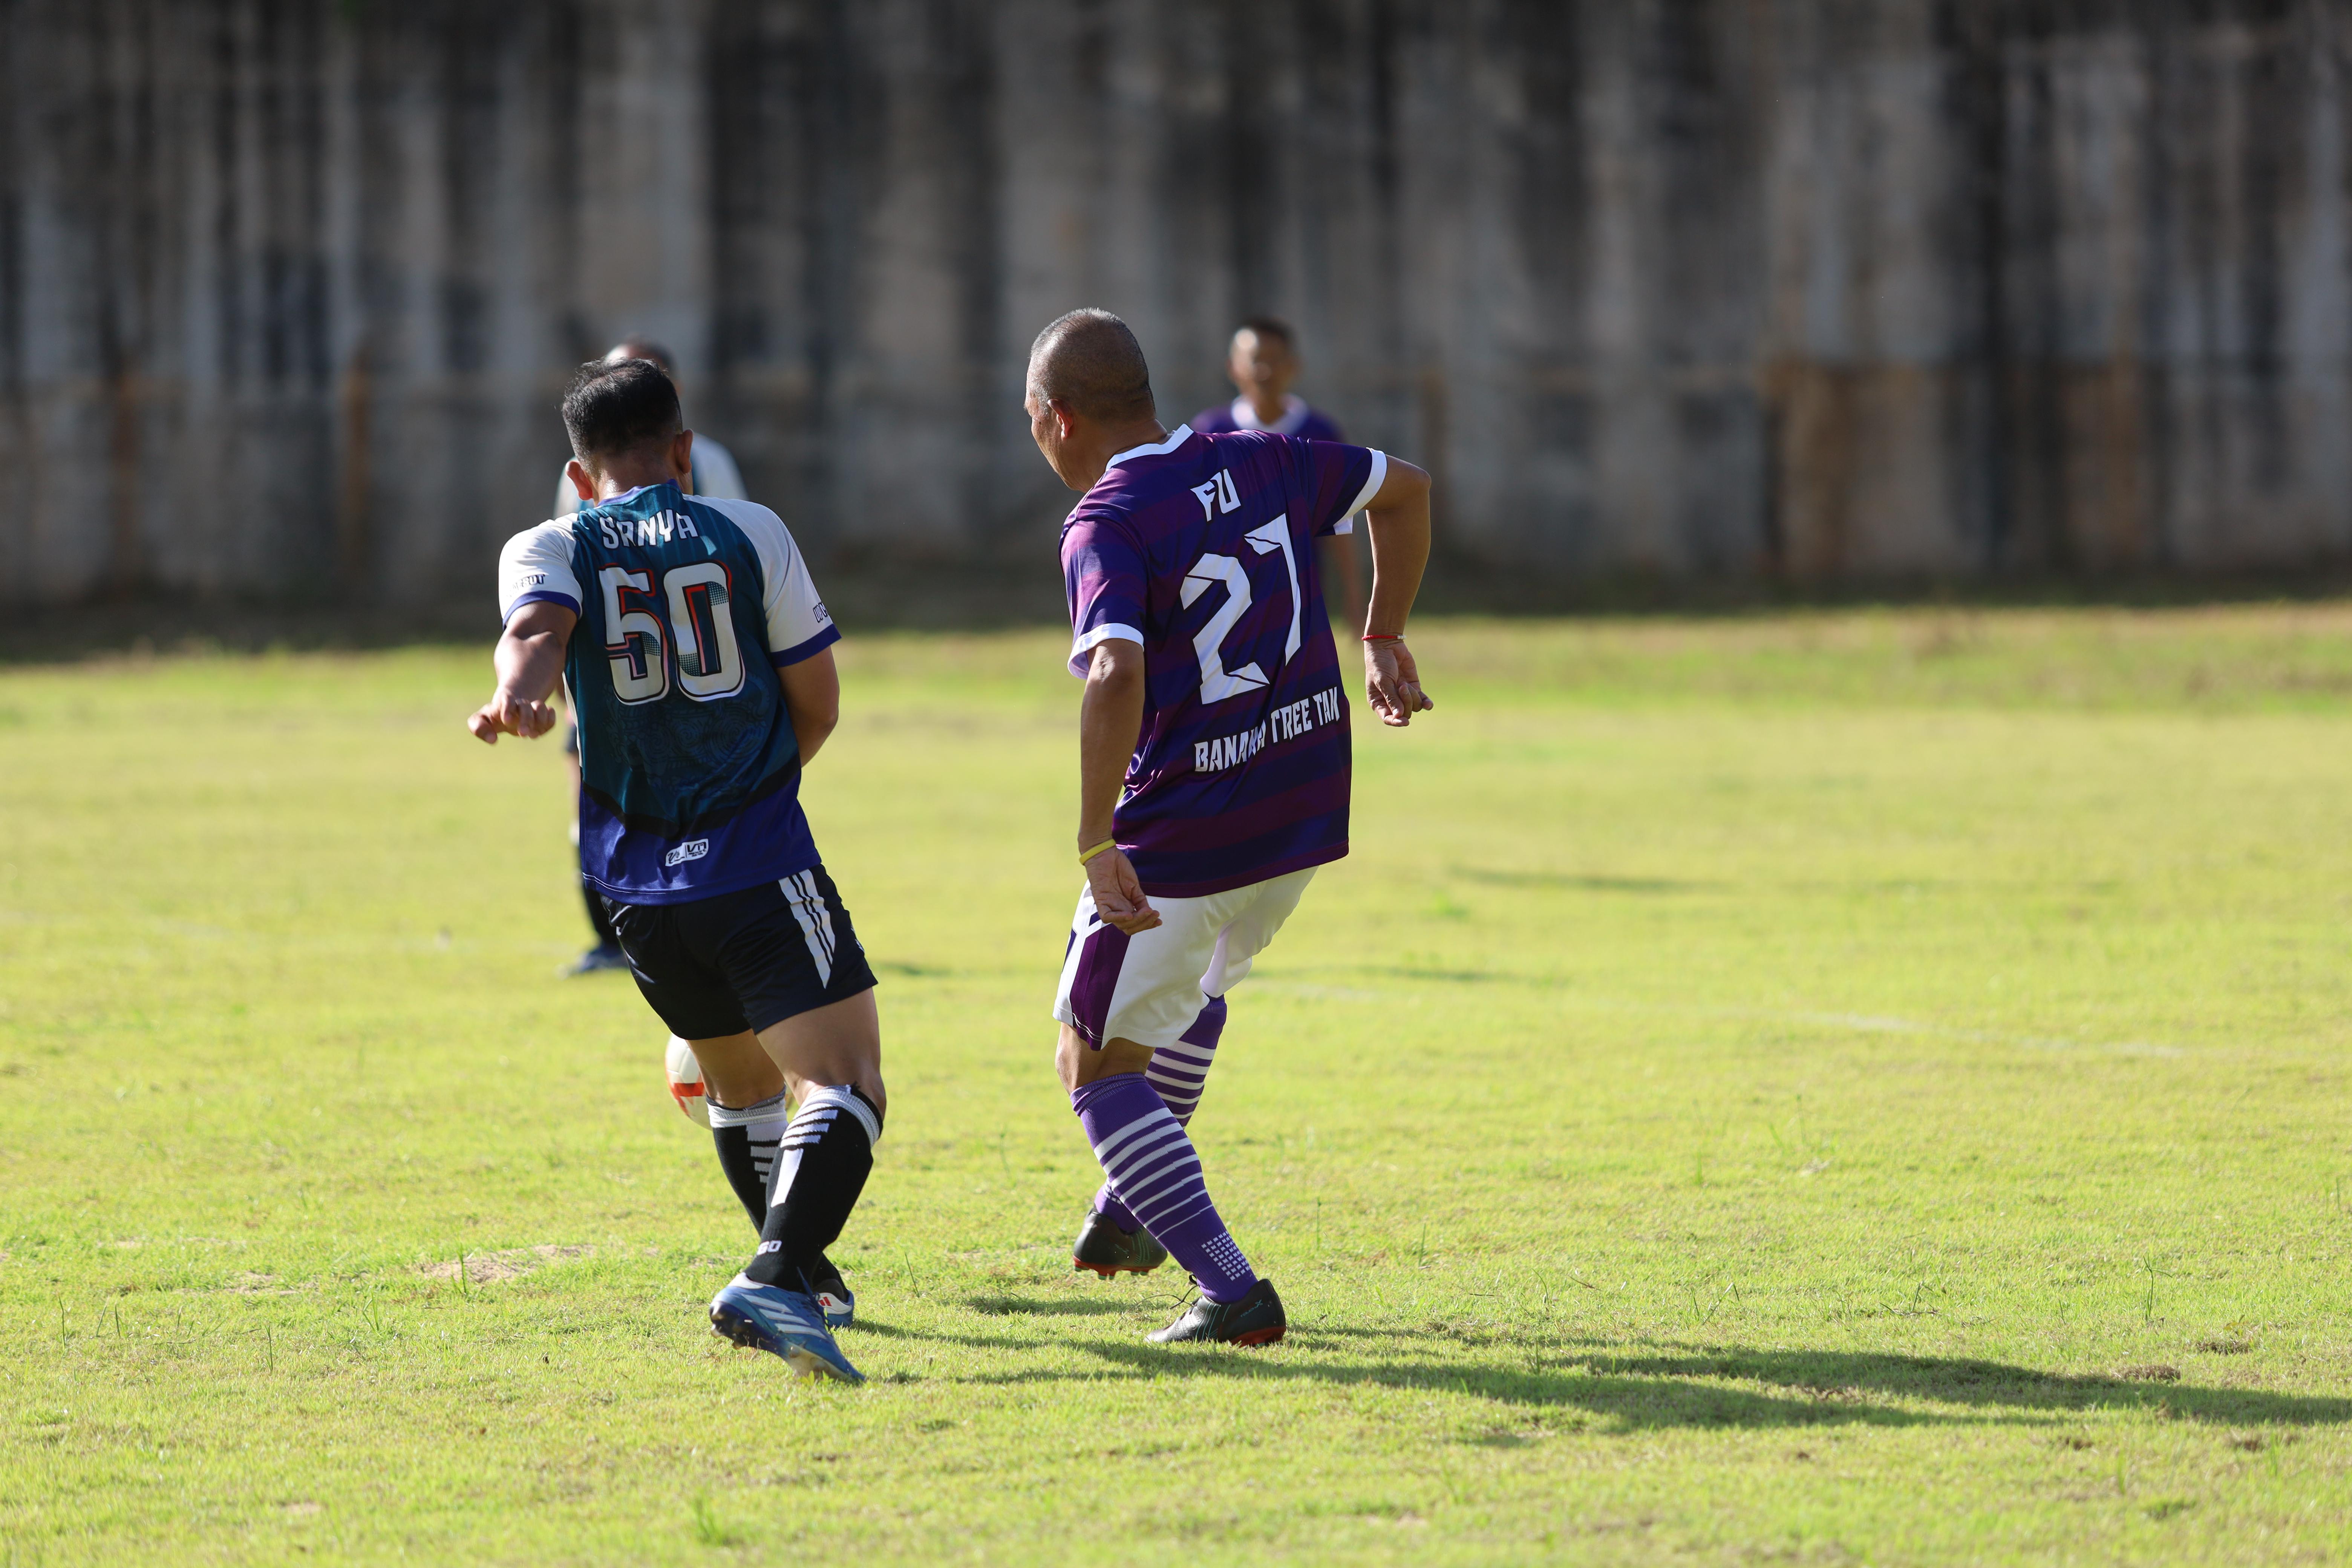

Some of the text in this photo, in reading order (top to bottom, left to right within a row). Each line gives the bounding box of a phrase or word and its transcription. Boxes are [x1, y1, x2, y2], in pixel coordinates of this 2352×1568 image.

[599, 509, 698, 549] SANYA
[1190, 468, 1241, 522] FU
[598, 559, 746, 706] 50
[1179, 513, 1301, 705] 27
[1194, 719, 1266, 772] BANANA
[1271, 698, 1313, 743] TREE
